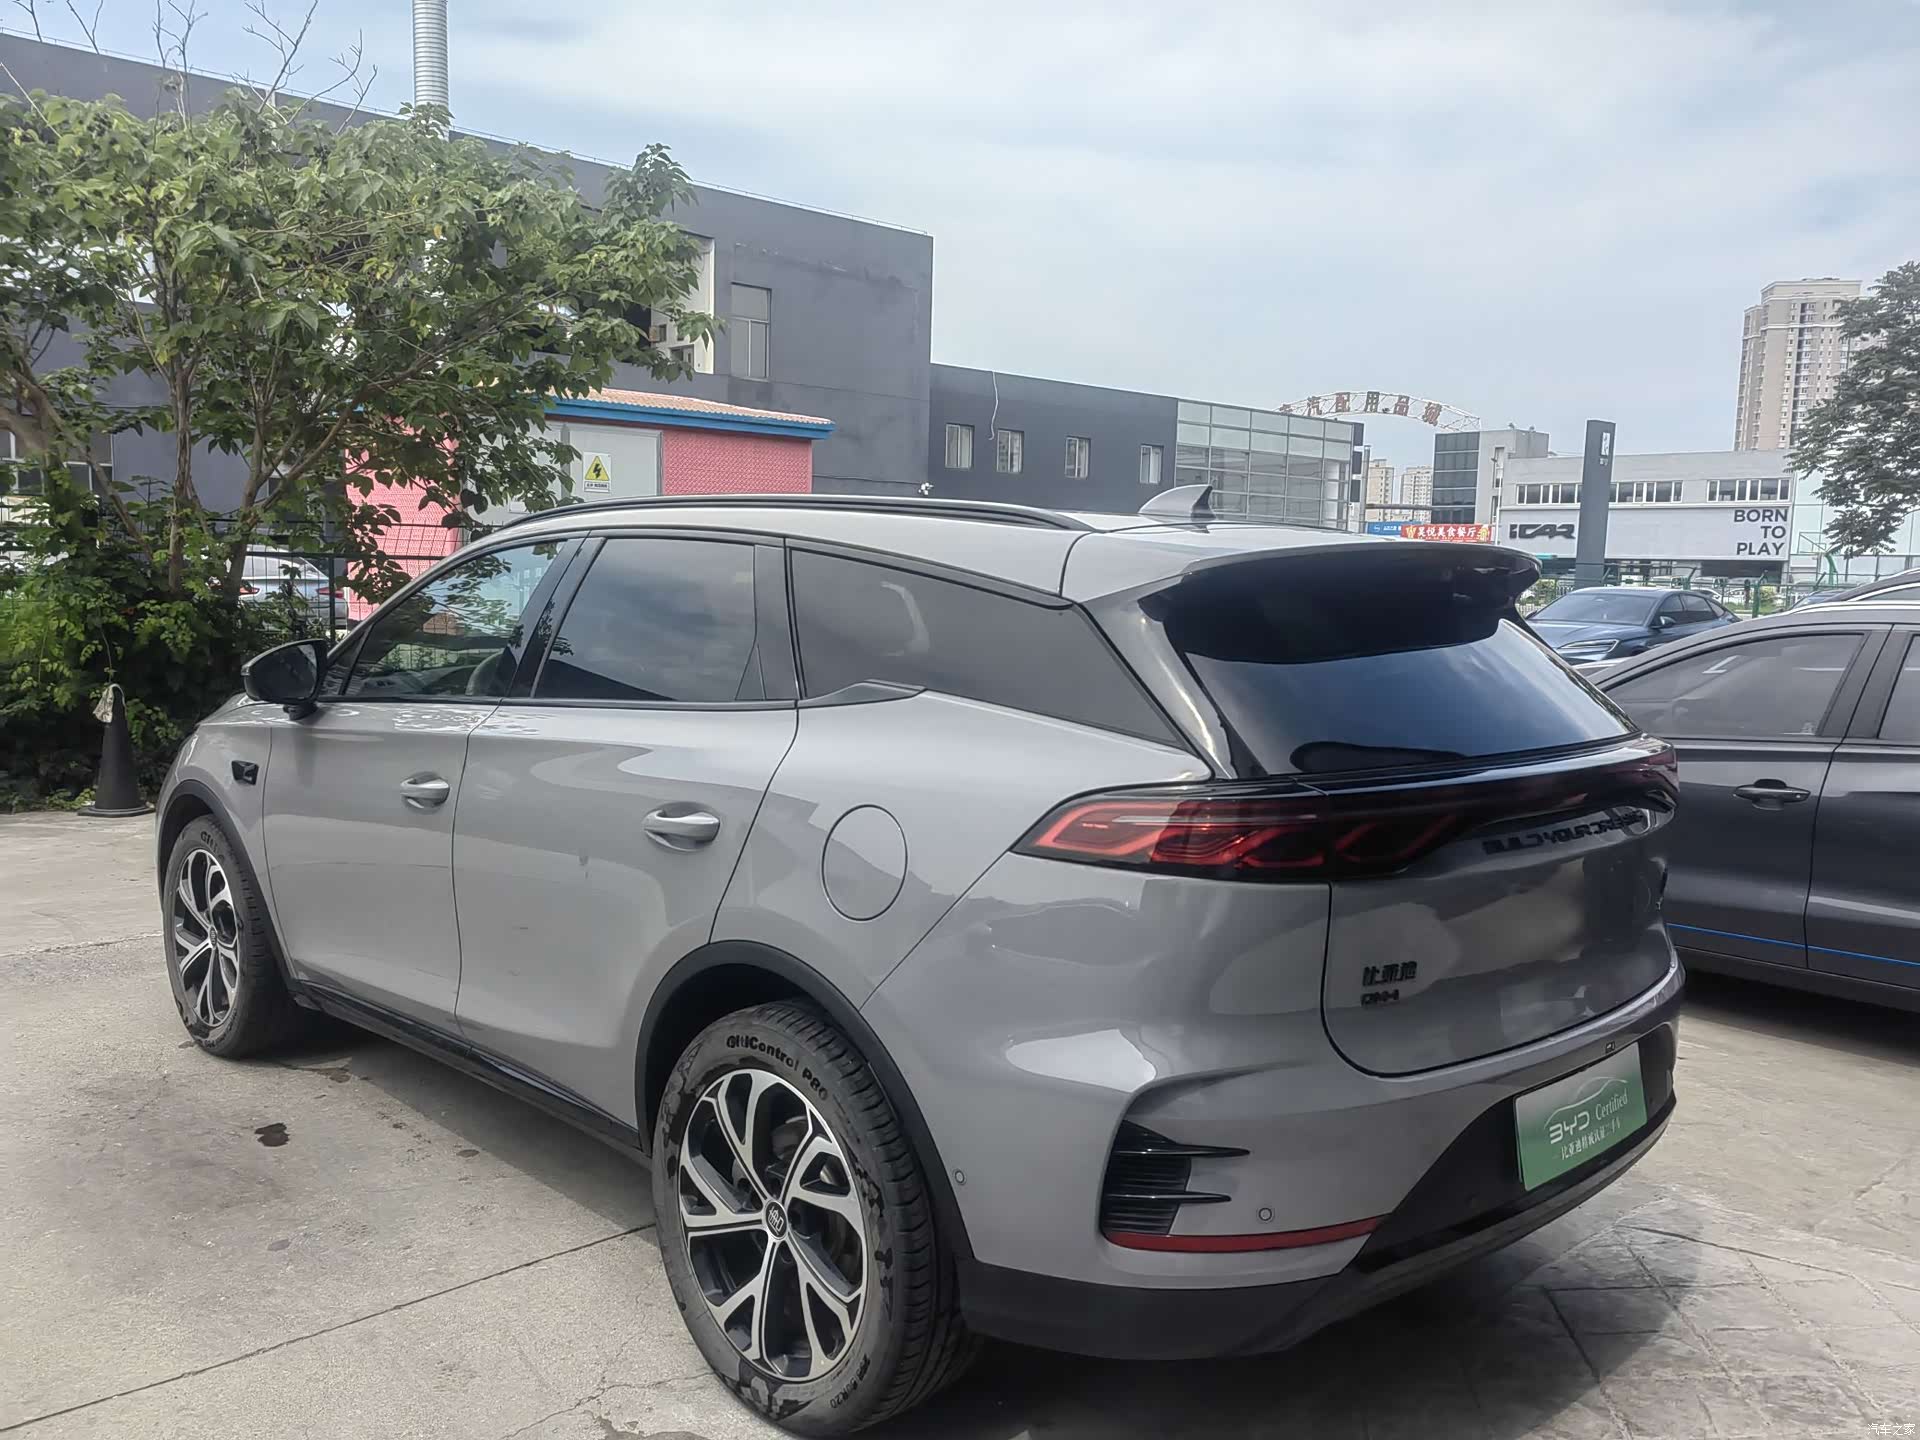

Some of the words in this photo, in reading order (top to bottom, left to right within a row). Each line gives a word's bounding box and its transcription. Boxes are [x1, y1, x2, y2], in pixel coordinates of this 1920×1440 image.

[1734, 509, 1789, 523] BORN
[1761, 525, 1787, 539] TO
[1737, 542, 1785, 556] PLAY
[802, 1066, 829, 1101] P80
[1549, 1111, 1590, 1145] BYD
[1595, 1088, 1628, 1121] Certified
